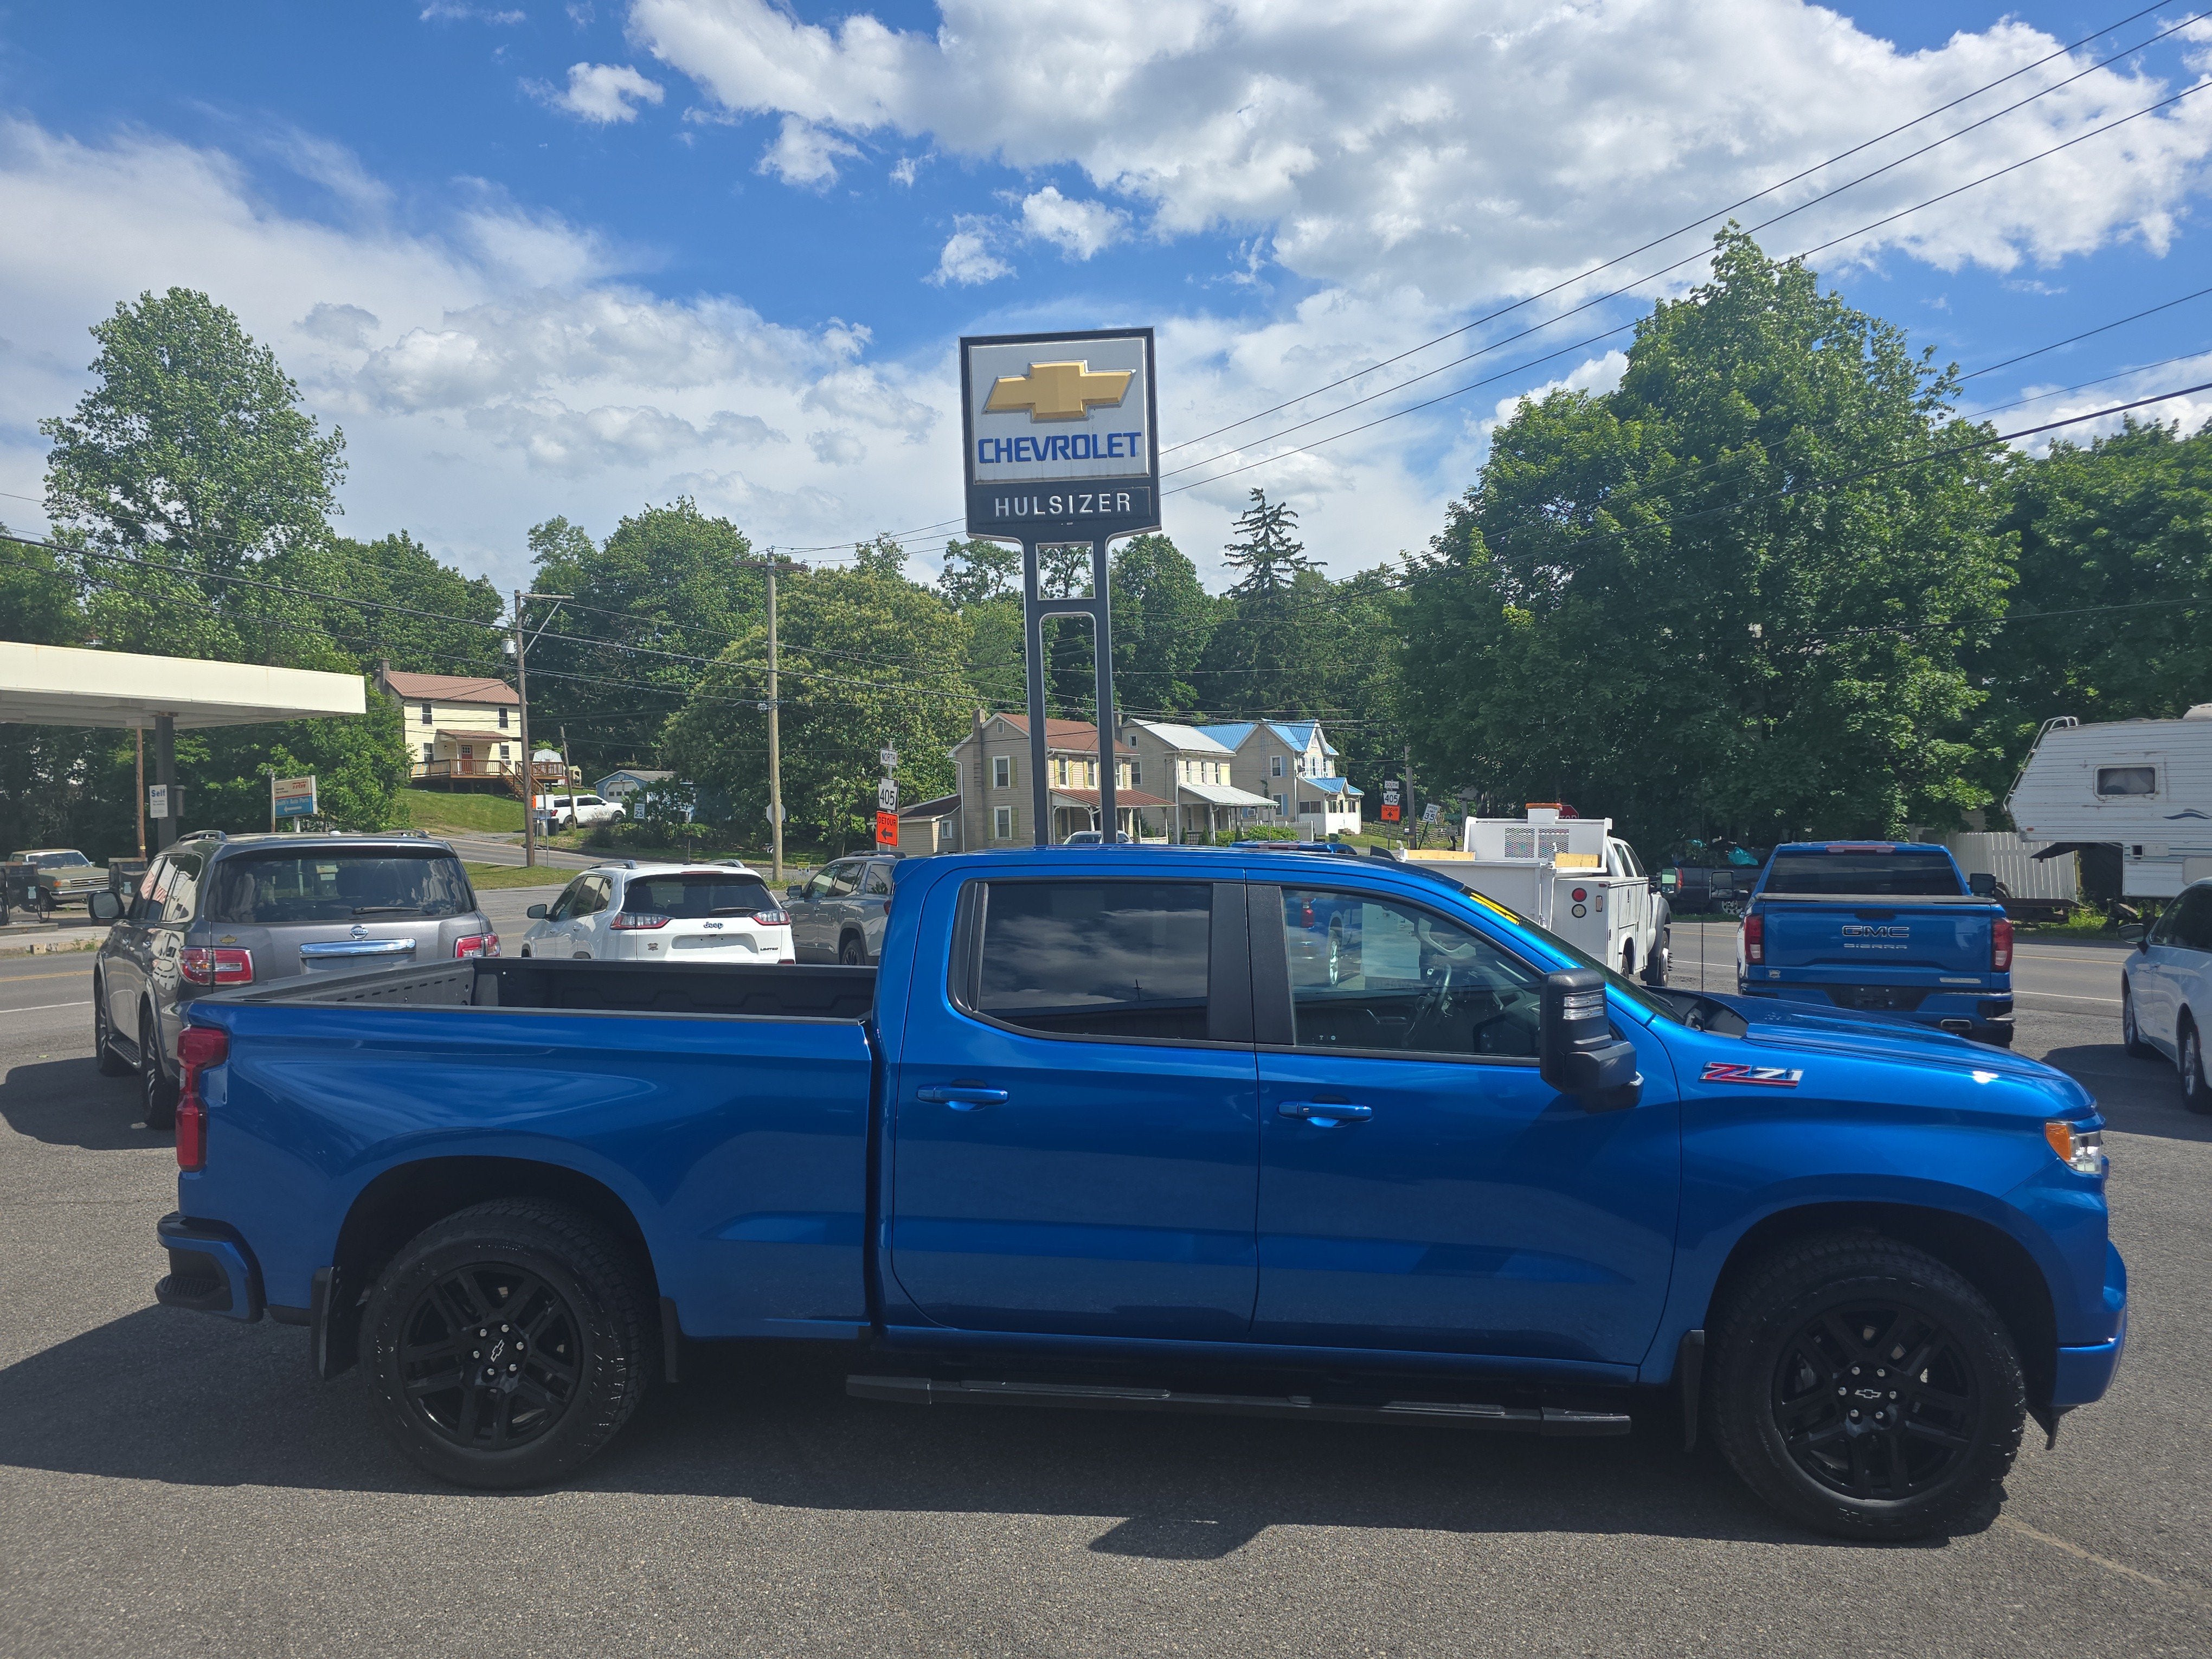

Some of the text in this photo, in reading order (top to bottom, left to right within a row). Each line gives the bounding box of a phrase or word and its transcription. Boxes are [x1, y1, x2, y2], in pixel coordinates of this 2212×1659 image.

[978, 432, 1141, 464] CHEVROLET
[995, 493, 1130, 517] HULSIZER
[882, 753, 896, 763] NORTH
[151, 788, 165, 797] Self
[879, 788, 895, 806] 405
[1385, 794, 1398, 803] 405
[878, 816, 896, 827] DETOUR
[1424, 813, 1436, 821] 35
[1842, 925, 1909, 937] GMC
[1699, 1061, 1804, 1086] Z71
